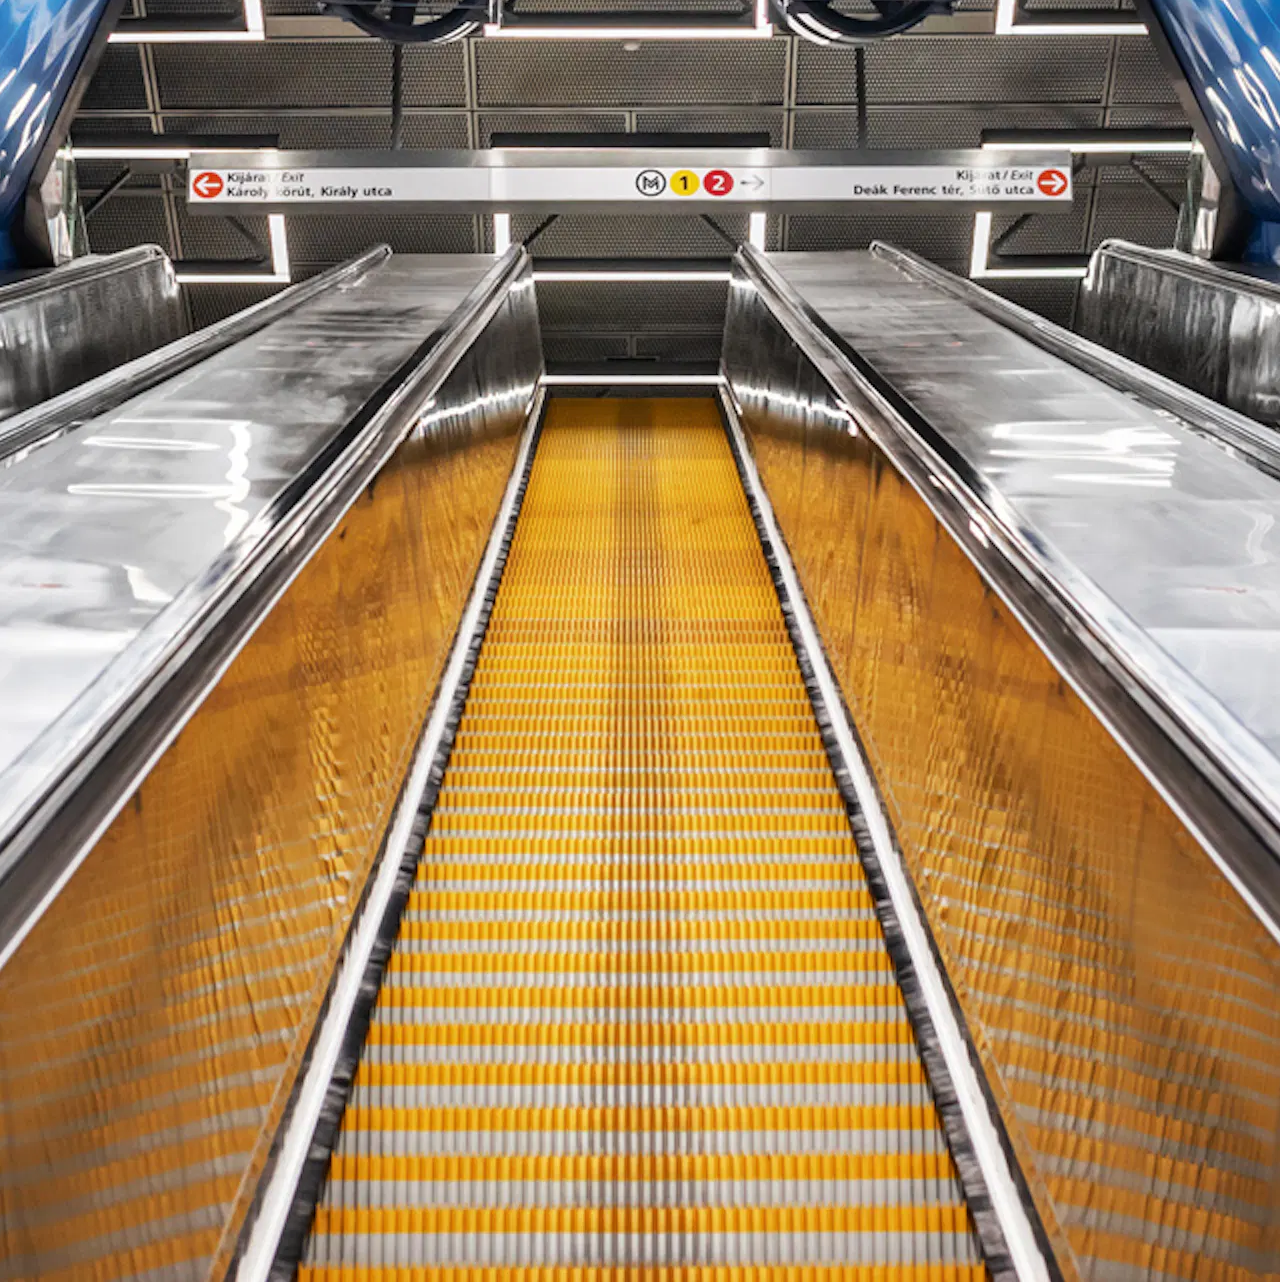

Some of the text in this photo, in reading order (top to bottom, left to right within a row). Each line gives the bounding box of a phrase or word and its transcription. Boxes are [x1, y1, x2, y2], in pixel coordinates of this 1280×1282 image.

[227, 171, 271, 185] Kijára
[281, 171, 305, 183] Exit
[955, 169, 1001, 183] Kijat
[1010, 169, 1034, 181] Exit
[226, 185, 268, 199] Károly
[320, 185, 359, 199] Király
[363, 187, 393, 197] utca
[853, 183, 888, 195] Deák
[893, 184, 936, 195] Ferenc
[941, 183, 965, 197] tér,
[1004, 185, 1035, 195] utca
